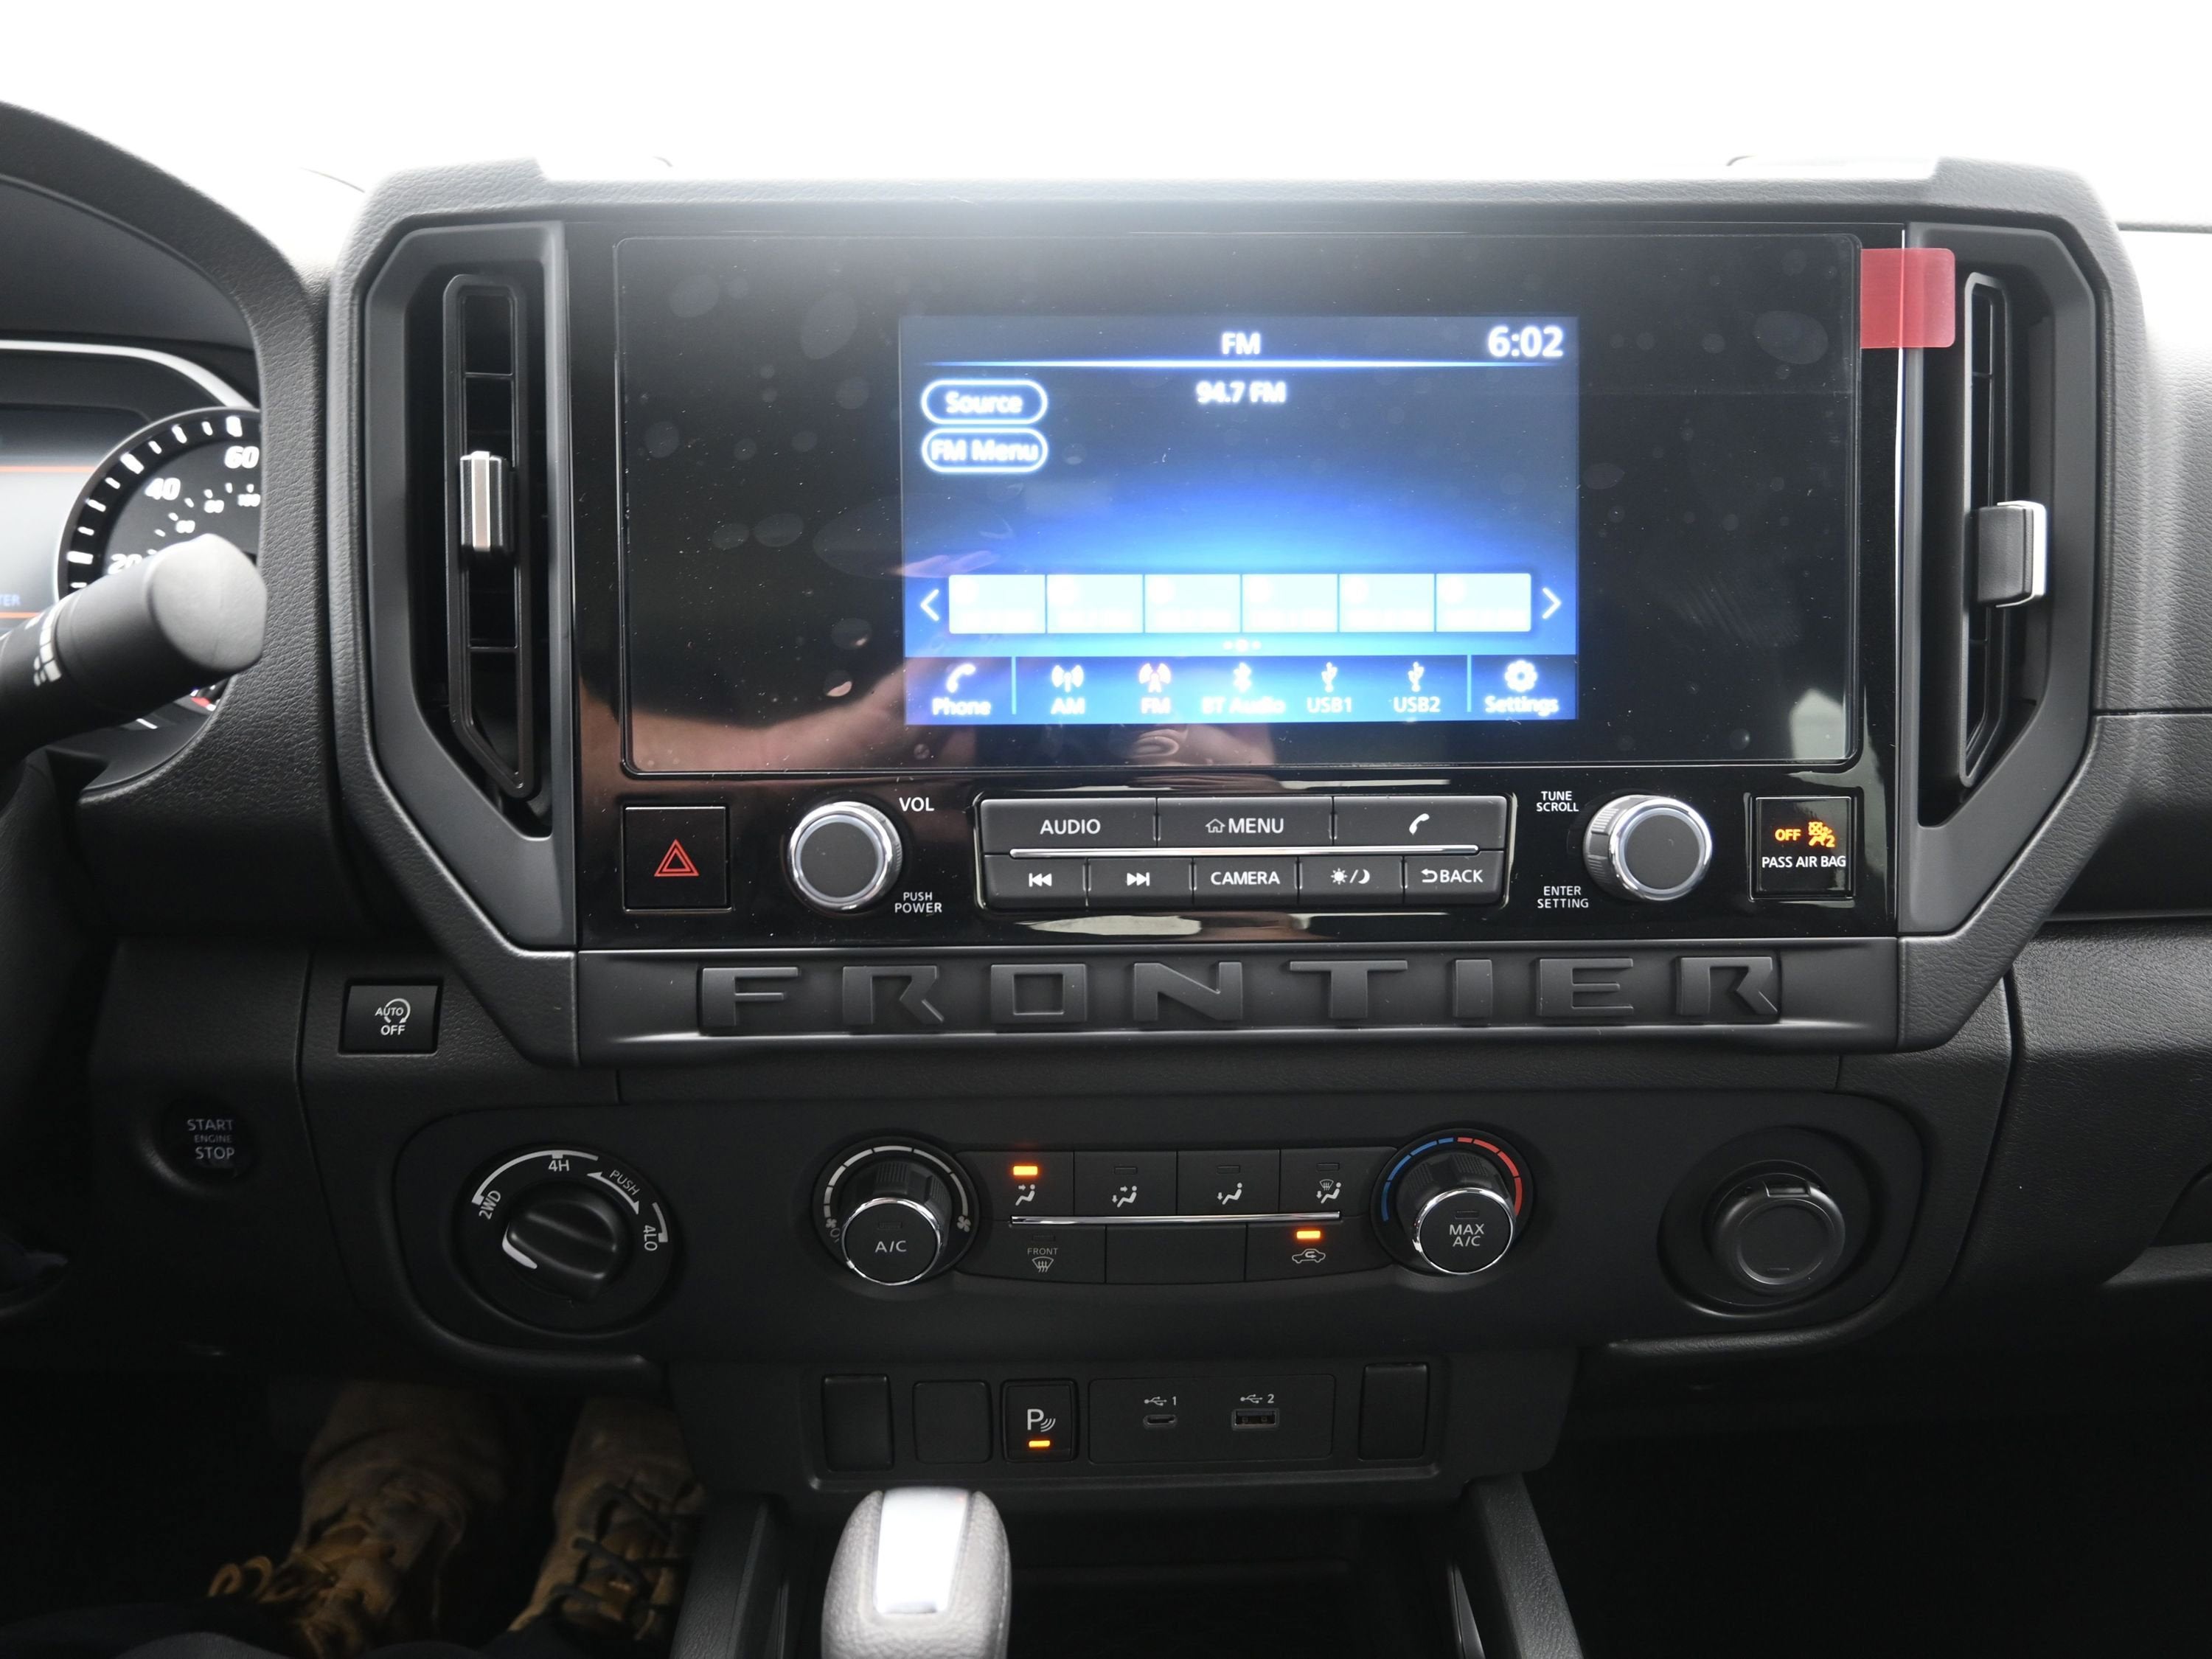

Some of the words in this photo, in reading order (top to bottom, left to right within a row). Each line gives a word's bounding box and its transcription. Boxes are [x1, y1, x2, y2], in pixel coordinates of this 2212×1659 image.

[1221, 332, 1261, 355] FM
[1487, 325, 1564, 358] 6:02
[1195, 380, 1245, 403] 94.7
[1249, 380, 1287, 403] FM
[945, 391, 1023, 414] Source
[223, 445, 260, 469] 60
[931, 439, 967, 462] FM
[971, 439, 1039, 462] Menu
[144, 477, 181, 501] 40
[932, 697, 992, 716] Phone
[1051, 697, 1085, 715] AM
[1141, 696, 1171, 715] FM
[1202, 696, 1226, 715] BT
[1229, 695, 1286, 714] Audio
[1307, 696, 1352, 714] USB1
[1394, 696, 1441, 714] USB2
[1485, 695, 1559, 717] Settings
[1540, 790, 1573, 801] TUNE
[899, 796, 935, 812] VOL
[1536, 801, 1579, 813] SCROLL
[1040, 818, 1101, 835] AUDIO
[1228, 818, 1284, 834] MENU
[1775, 828, 1801, 841] OFF
[1761, 855, 1793, 869] PASS
[1795, 855, 1818, 868] AIR
[1820, 855, 1846, 868] BAG
[1210, 870, 1281, 886] CAMERA
[1440, 869, 1484, 883] BACK
[902, 891, 933, 902] PUSH
[1543, 886, 1582, 897] ENTER
[894, 902, 942, 914] POWER
[1537, 897, 1589, 909] SETTING
[701, 956, 1778, 1029] FRONTIER
[375, 1006, 404, 1017] AUTO
[380, 1024, 406, 1036] OFF
[187, 1119, 234, 1132] START
[194, 1134, 232, 1144] ENGINE
[195, 1147, 235, 1160] STOP
[548, 1160, 570, 1172] 4H
[609, 1169, 640, 1195] PUSH
[479, 1190, 501, 1220] 2WD
[1450, 1222, 1484, 1235] MAX
[643, 1225, 658, 1251] 4LO
[1452, 1235, 1481, 1247] A/C
[874, 1240, 907, 1253] A/C
[1027, 1247, 1058, 1256] FRONT
[1172, 1396, 1177, 1406] 1
[1267, 1393, 1275, 1404] 2
[1027, 1409, 1043, 1430] P
